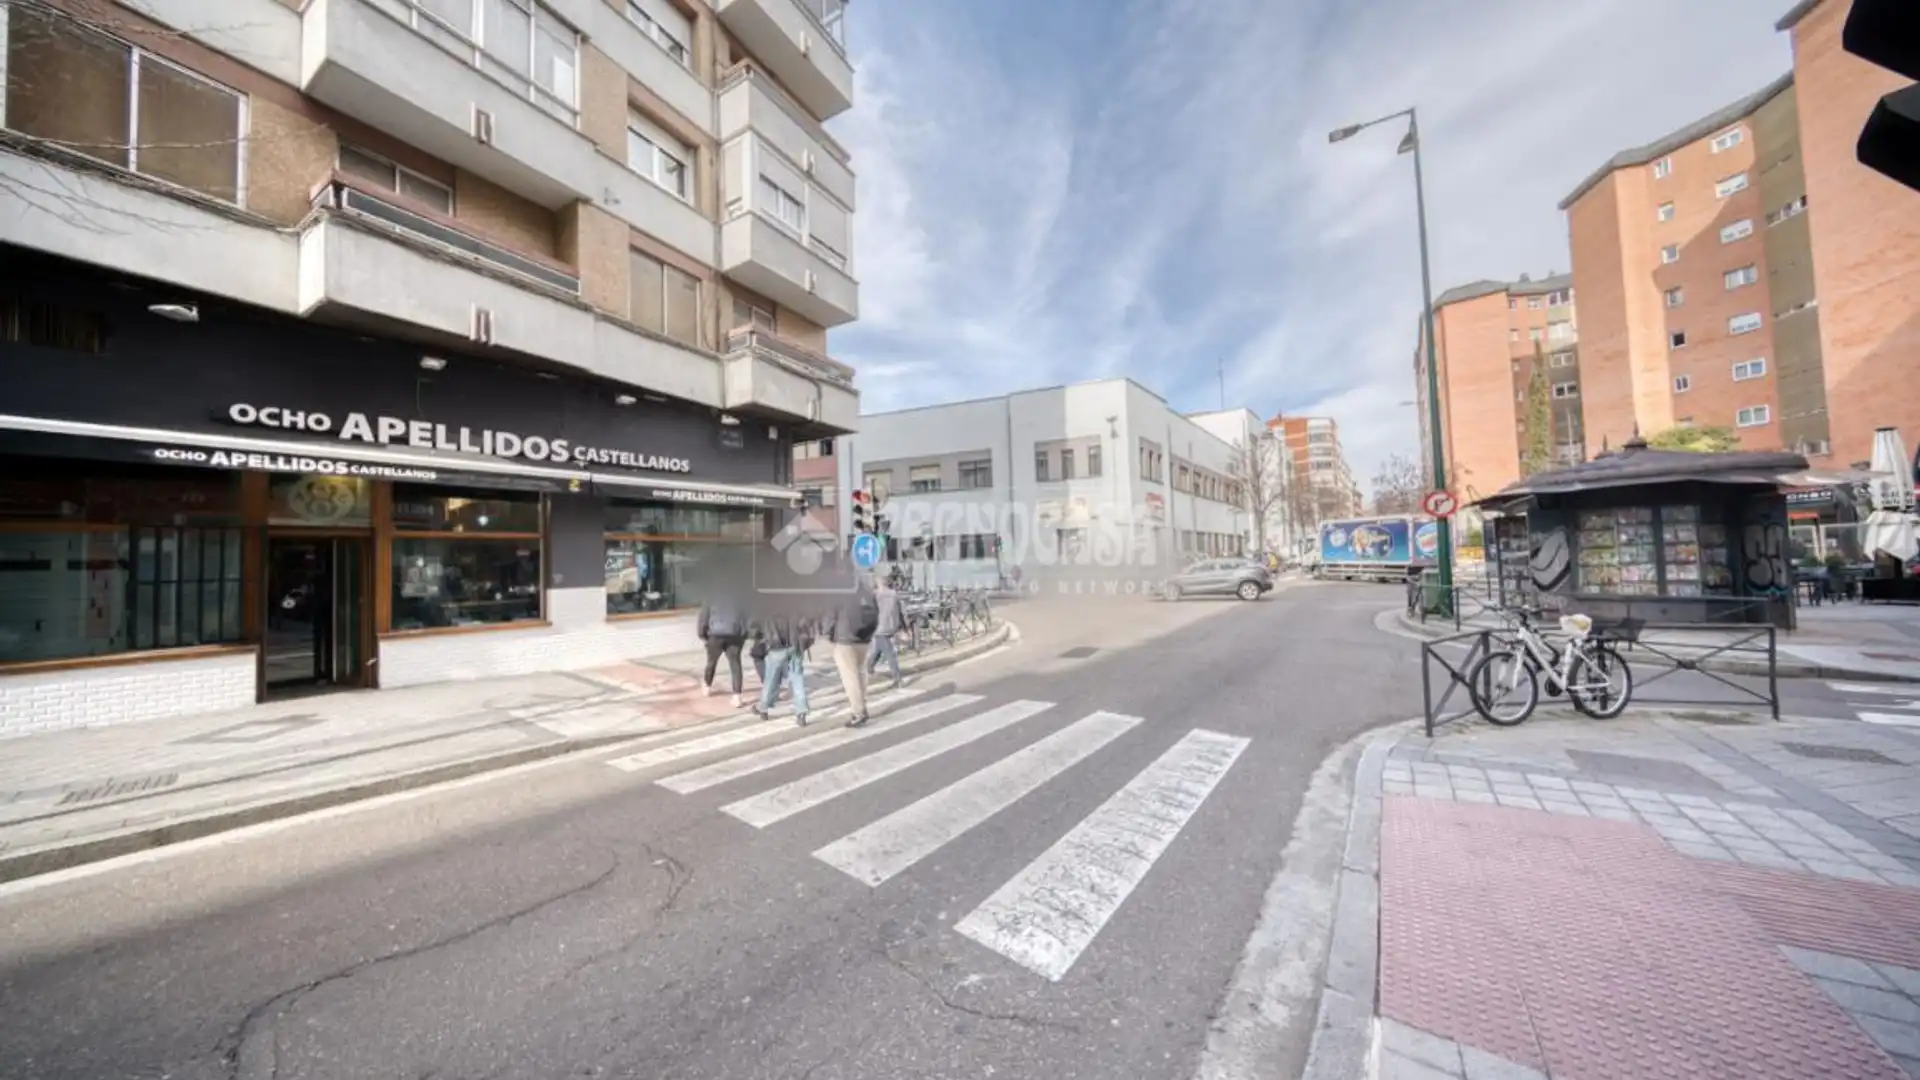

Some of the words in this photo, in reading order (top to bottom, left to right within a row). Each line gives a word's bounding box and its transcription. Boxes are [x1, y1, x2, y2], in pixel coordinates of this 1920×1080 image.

[228, 403, 332, 432] OCHO
[338, 412, 570, 463] APELLIDOS
[573, 446, 690, 473] CASTELLANOS
[154, 448, 207, 461] OCHO
[209, 450, 350, 475] APELLIDOS
[350, 464, 438, 480] CASTELLANOS
